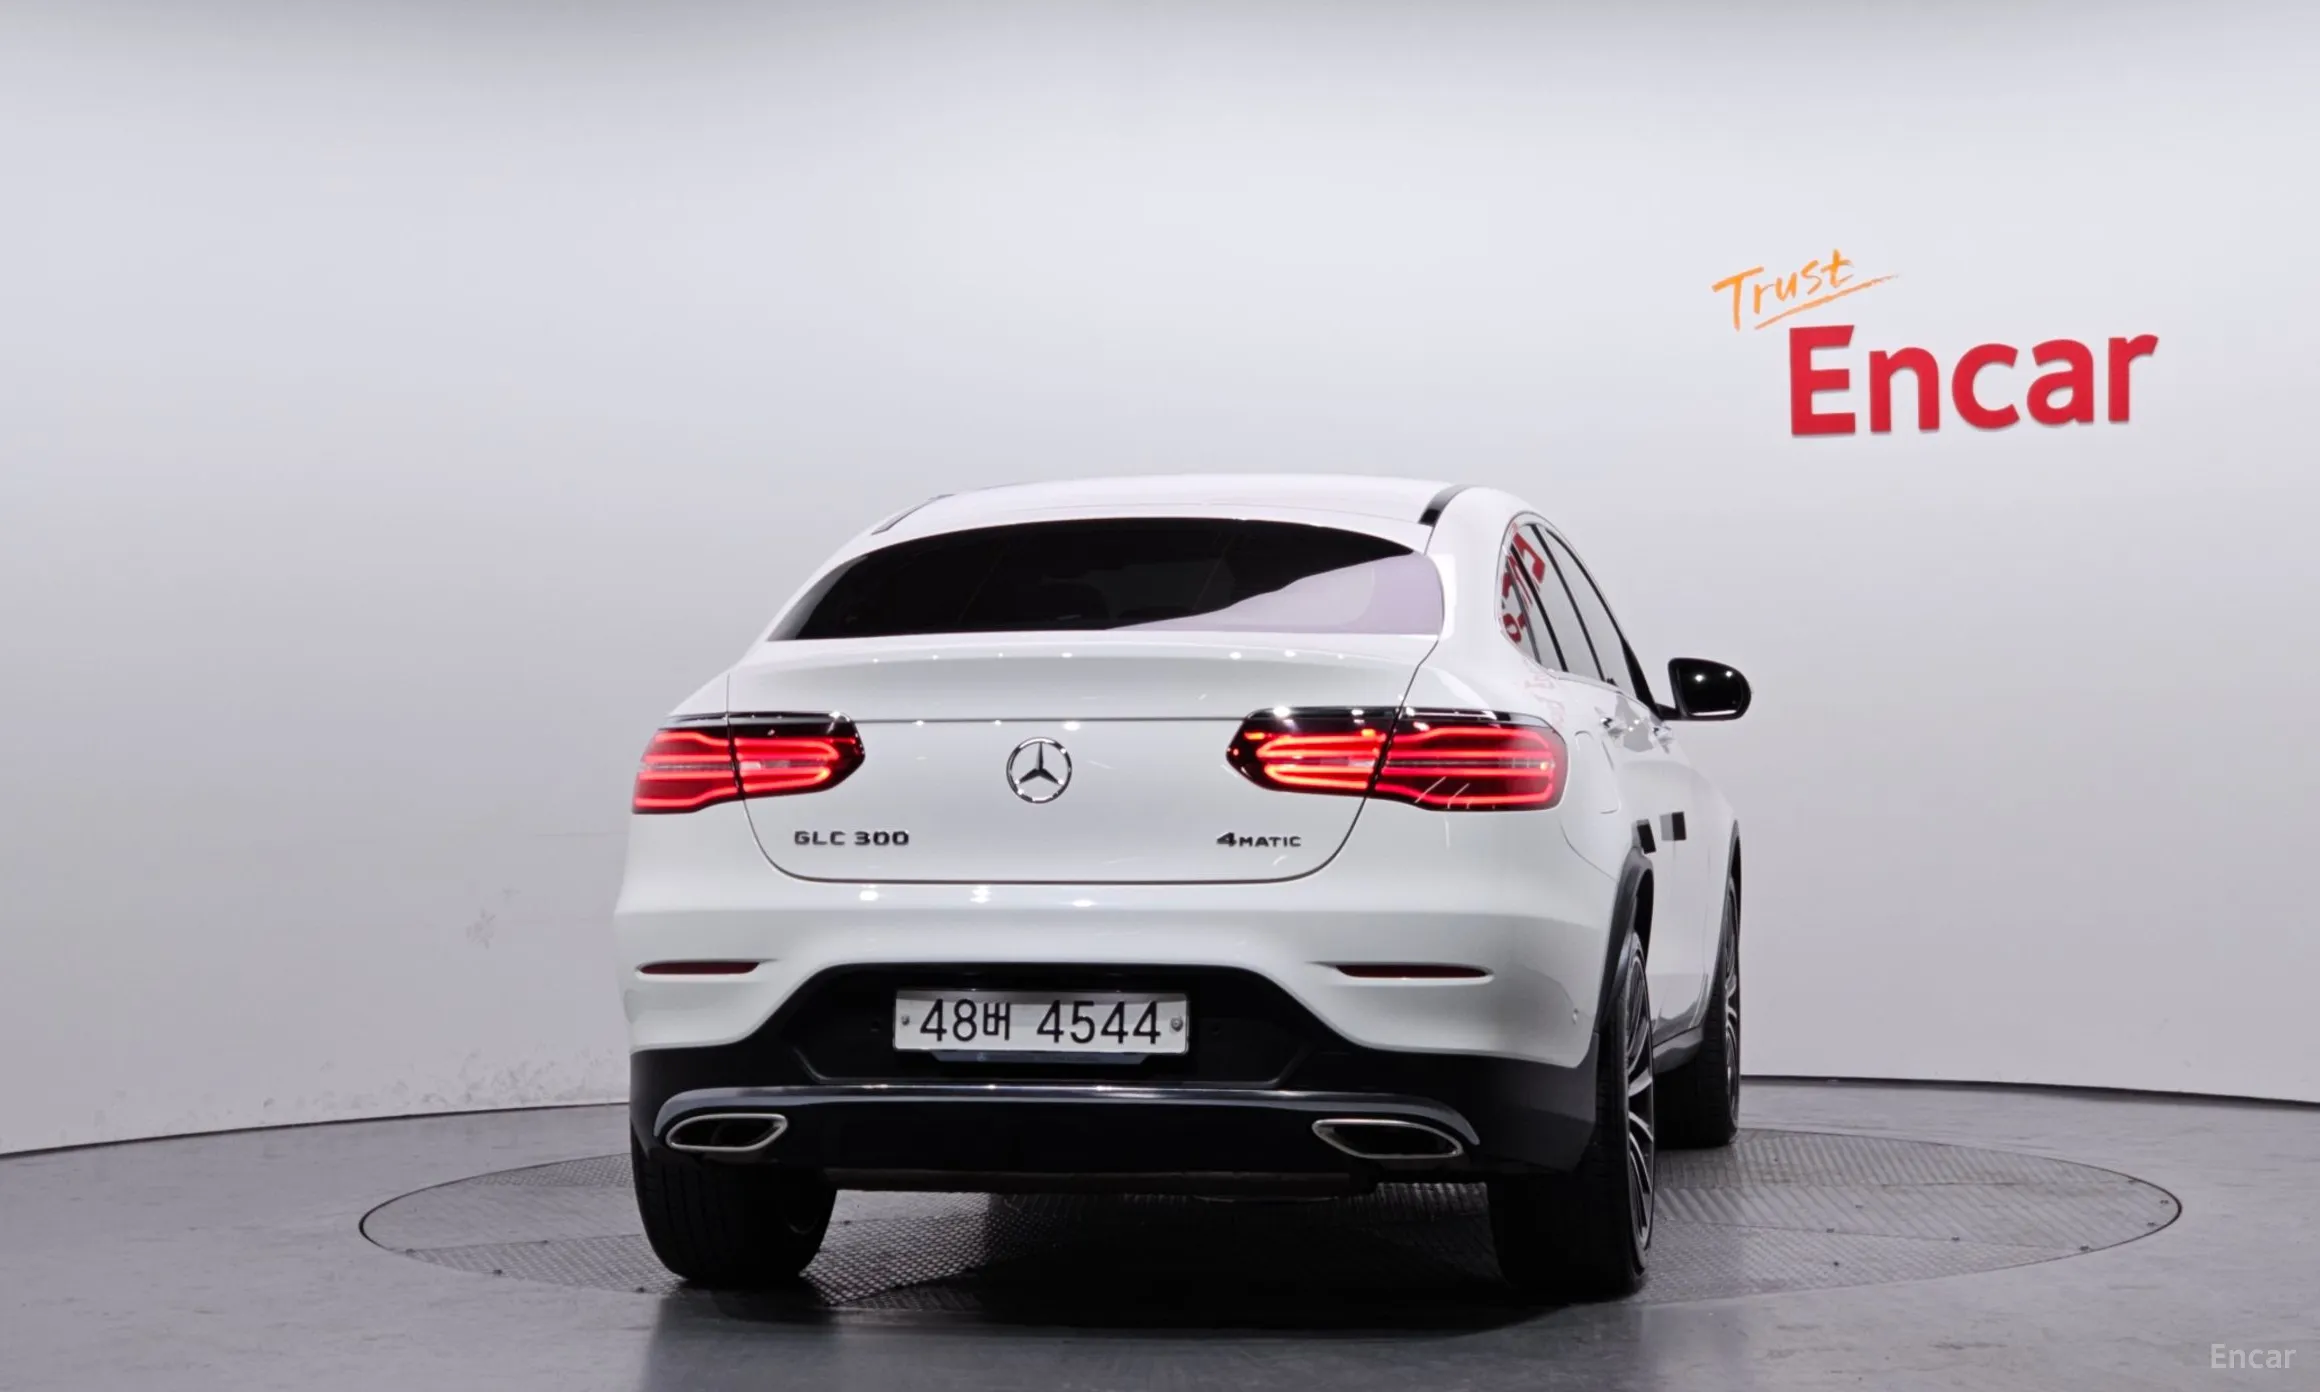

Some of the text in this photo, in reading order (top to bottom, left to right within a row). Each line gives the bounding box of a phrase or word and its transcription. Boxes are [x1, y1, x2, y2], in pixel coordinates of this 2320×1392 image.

[1711, 249, 1856, 331] Trust
[1789, 325, 2159, 437] Encar
[794, 830, 909, 846] GLC 300
[1216, 831, 1302, 847] 4MATIC
[919, 998, 1162, 1045] 48버 4544
